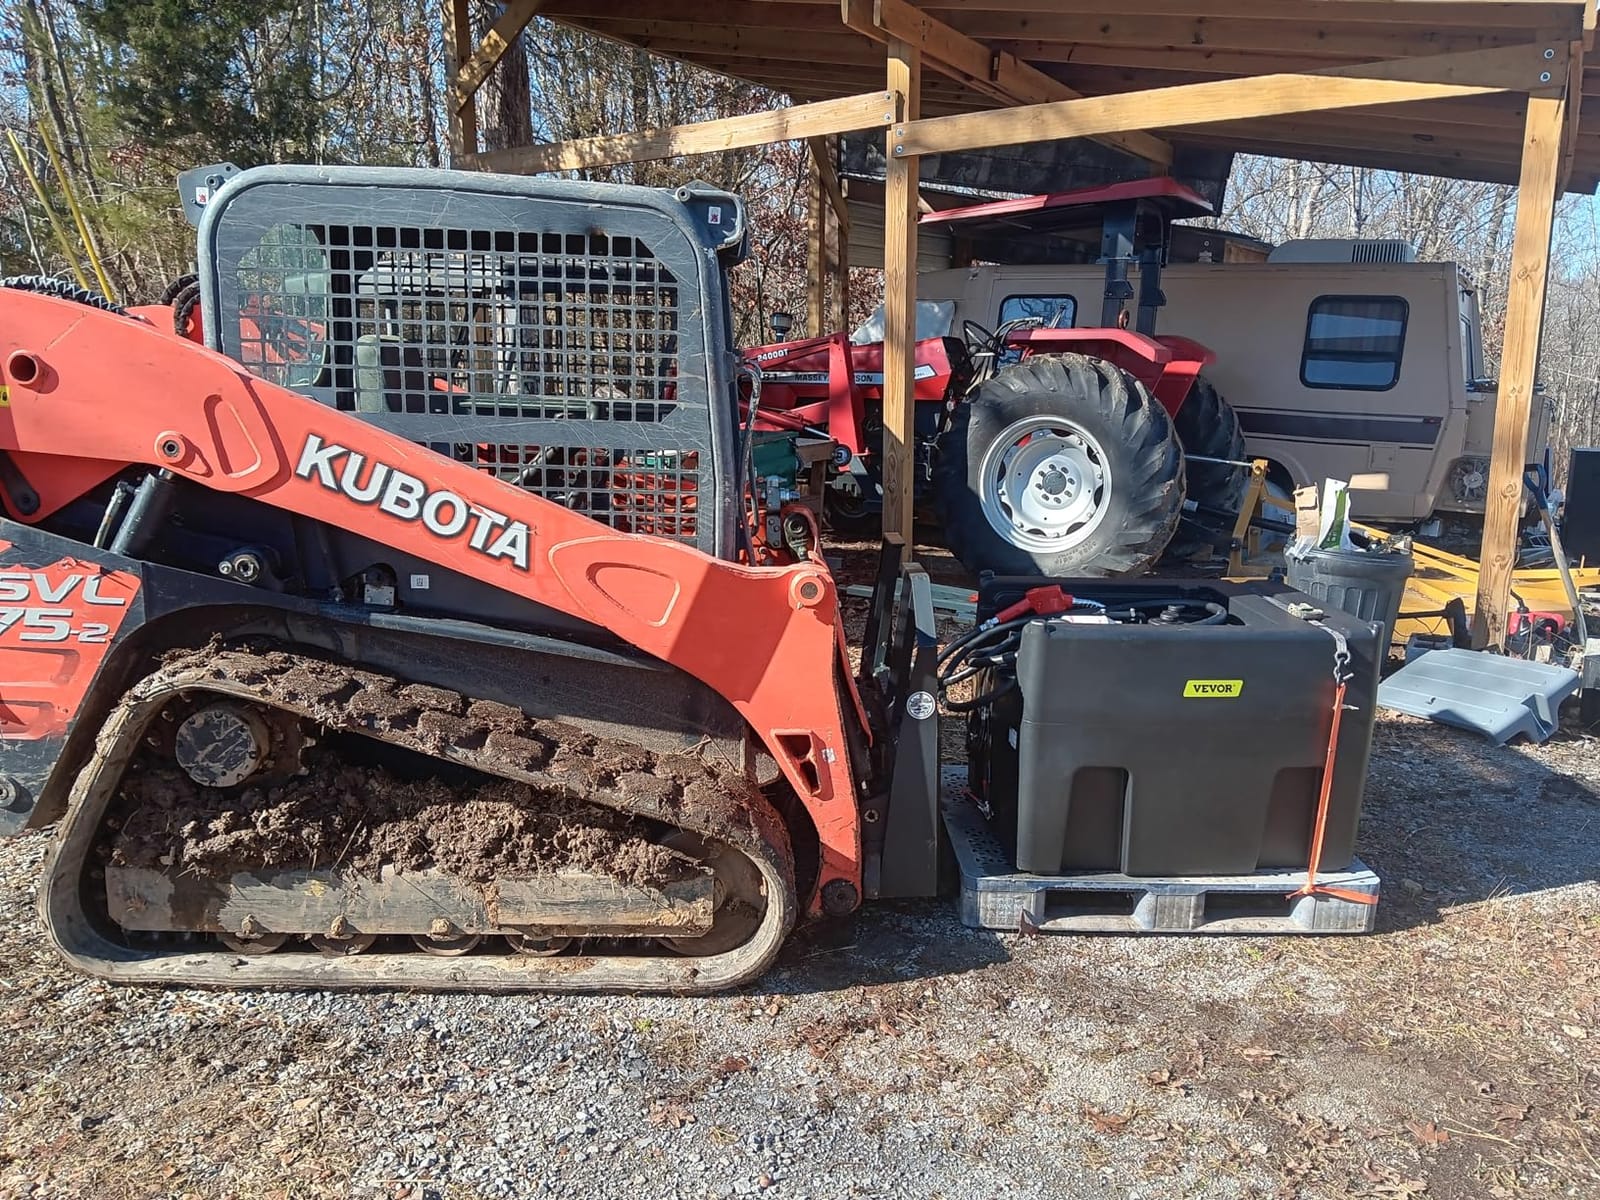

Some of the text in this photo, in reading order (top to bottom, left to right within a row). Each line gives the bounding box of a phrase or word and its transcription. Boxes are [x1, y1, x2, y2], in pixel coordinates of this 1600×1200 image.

[757, 348, 789, 362] 2400QT
[794, 373, 827, 382] MASSEY
[295, 432, 531, 571] KUBOTA
[0, 571, 126, 605] SVL
[1193, 683, 1233, 693] VEVOR
